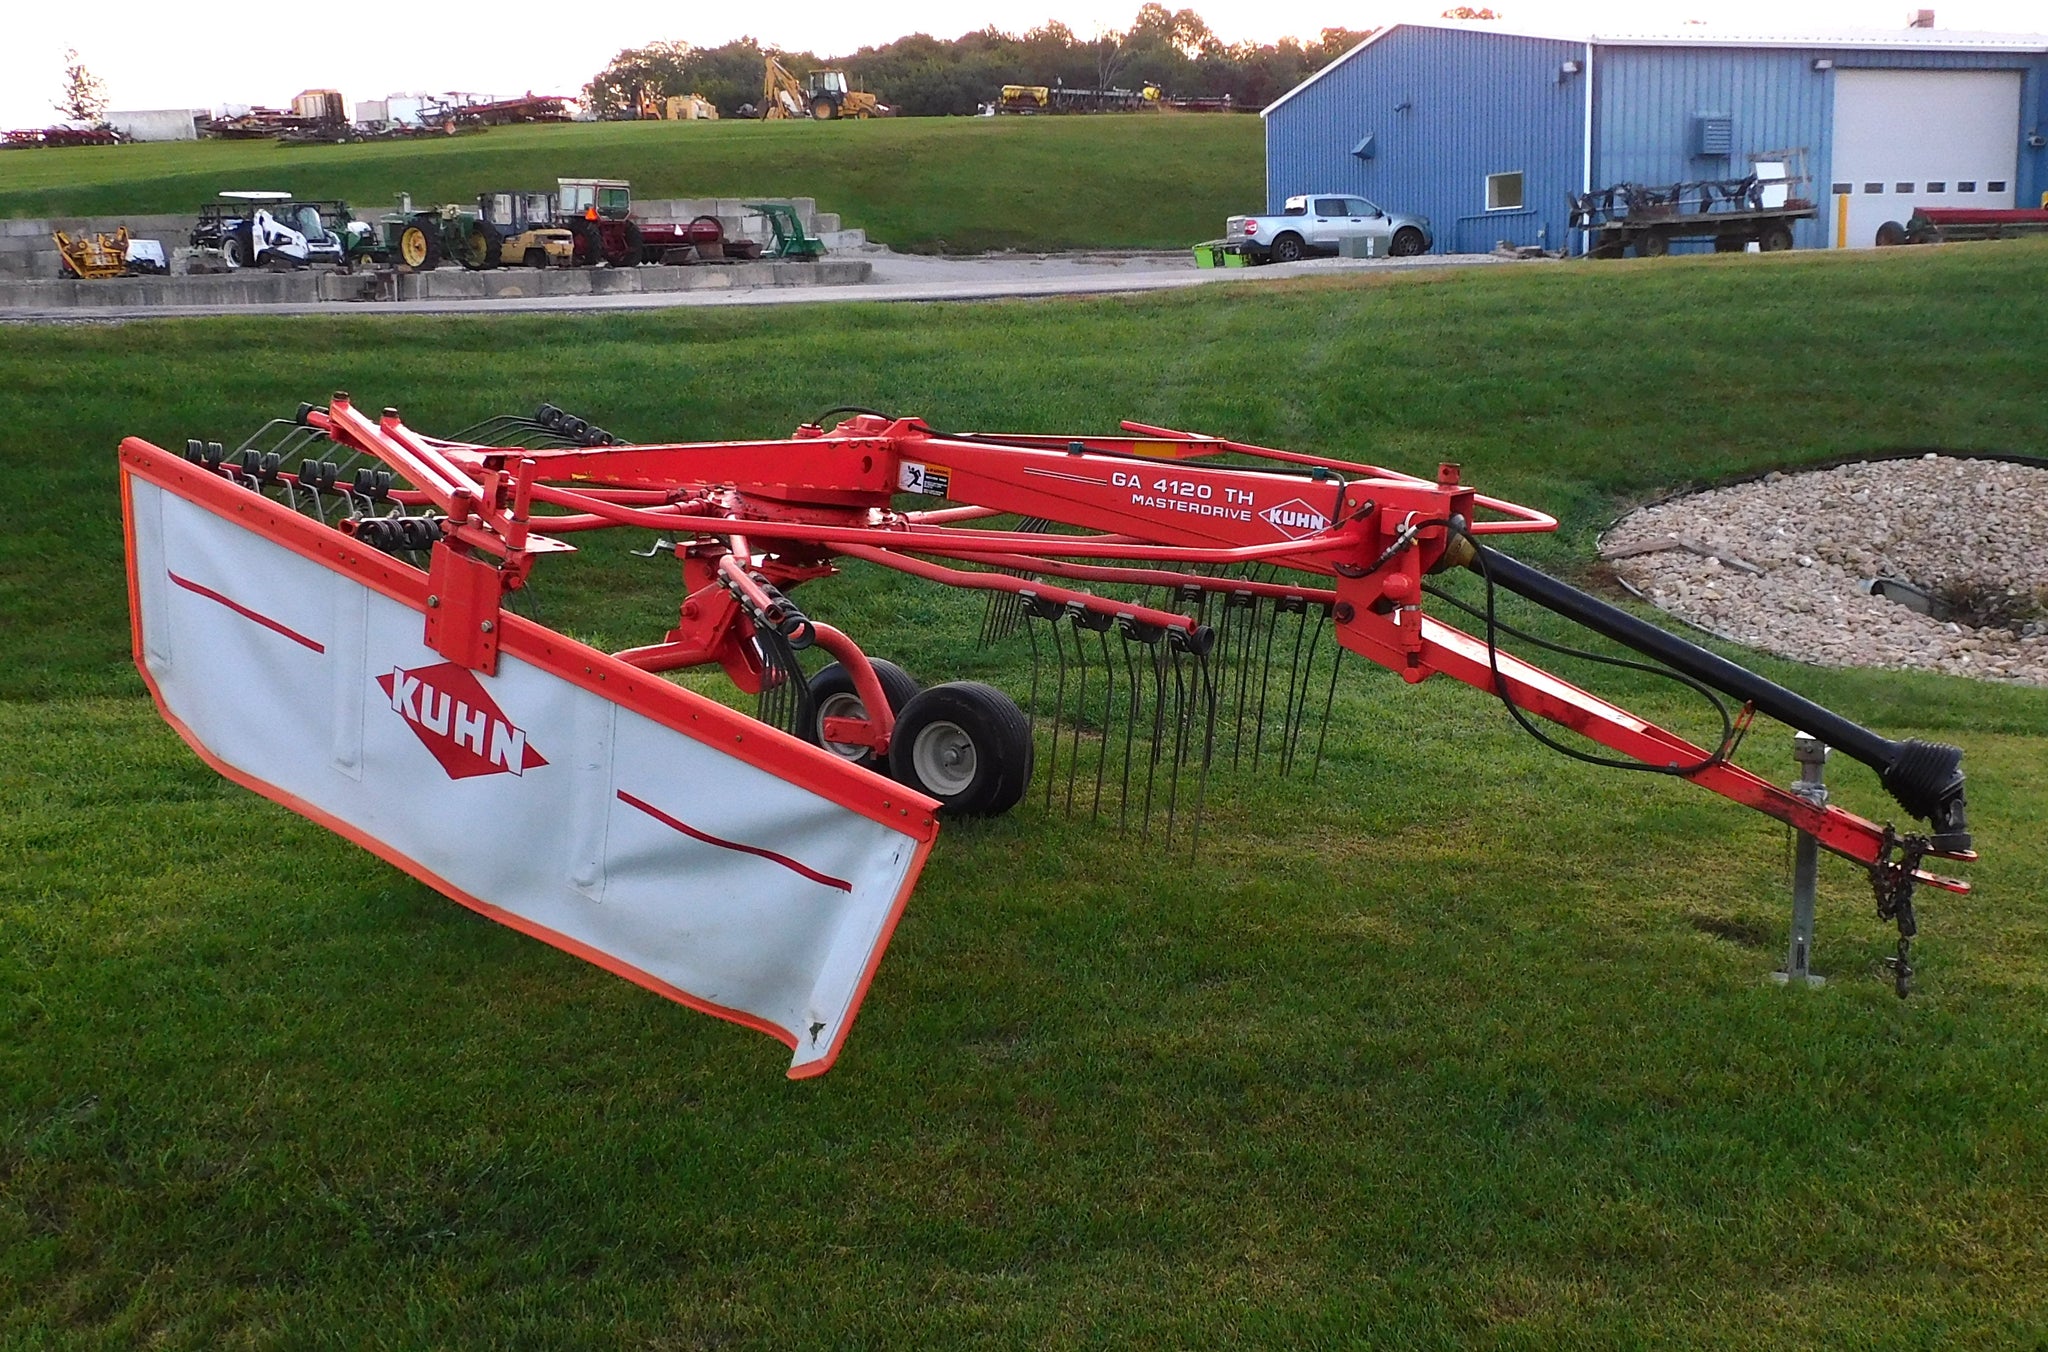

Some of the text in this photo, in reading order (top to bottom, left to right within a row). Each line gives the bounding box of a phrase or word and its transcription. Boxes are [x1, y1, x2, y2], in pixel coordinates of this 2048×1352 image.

[1112, 471, 1254, 506] GA 4120 TH
[1131, 493, 1252, 522] MASTERDRIVE
[1269, 508, 1324, 530] KUHN
[391, 665, 526, 777] KUHN
